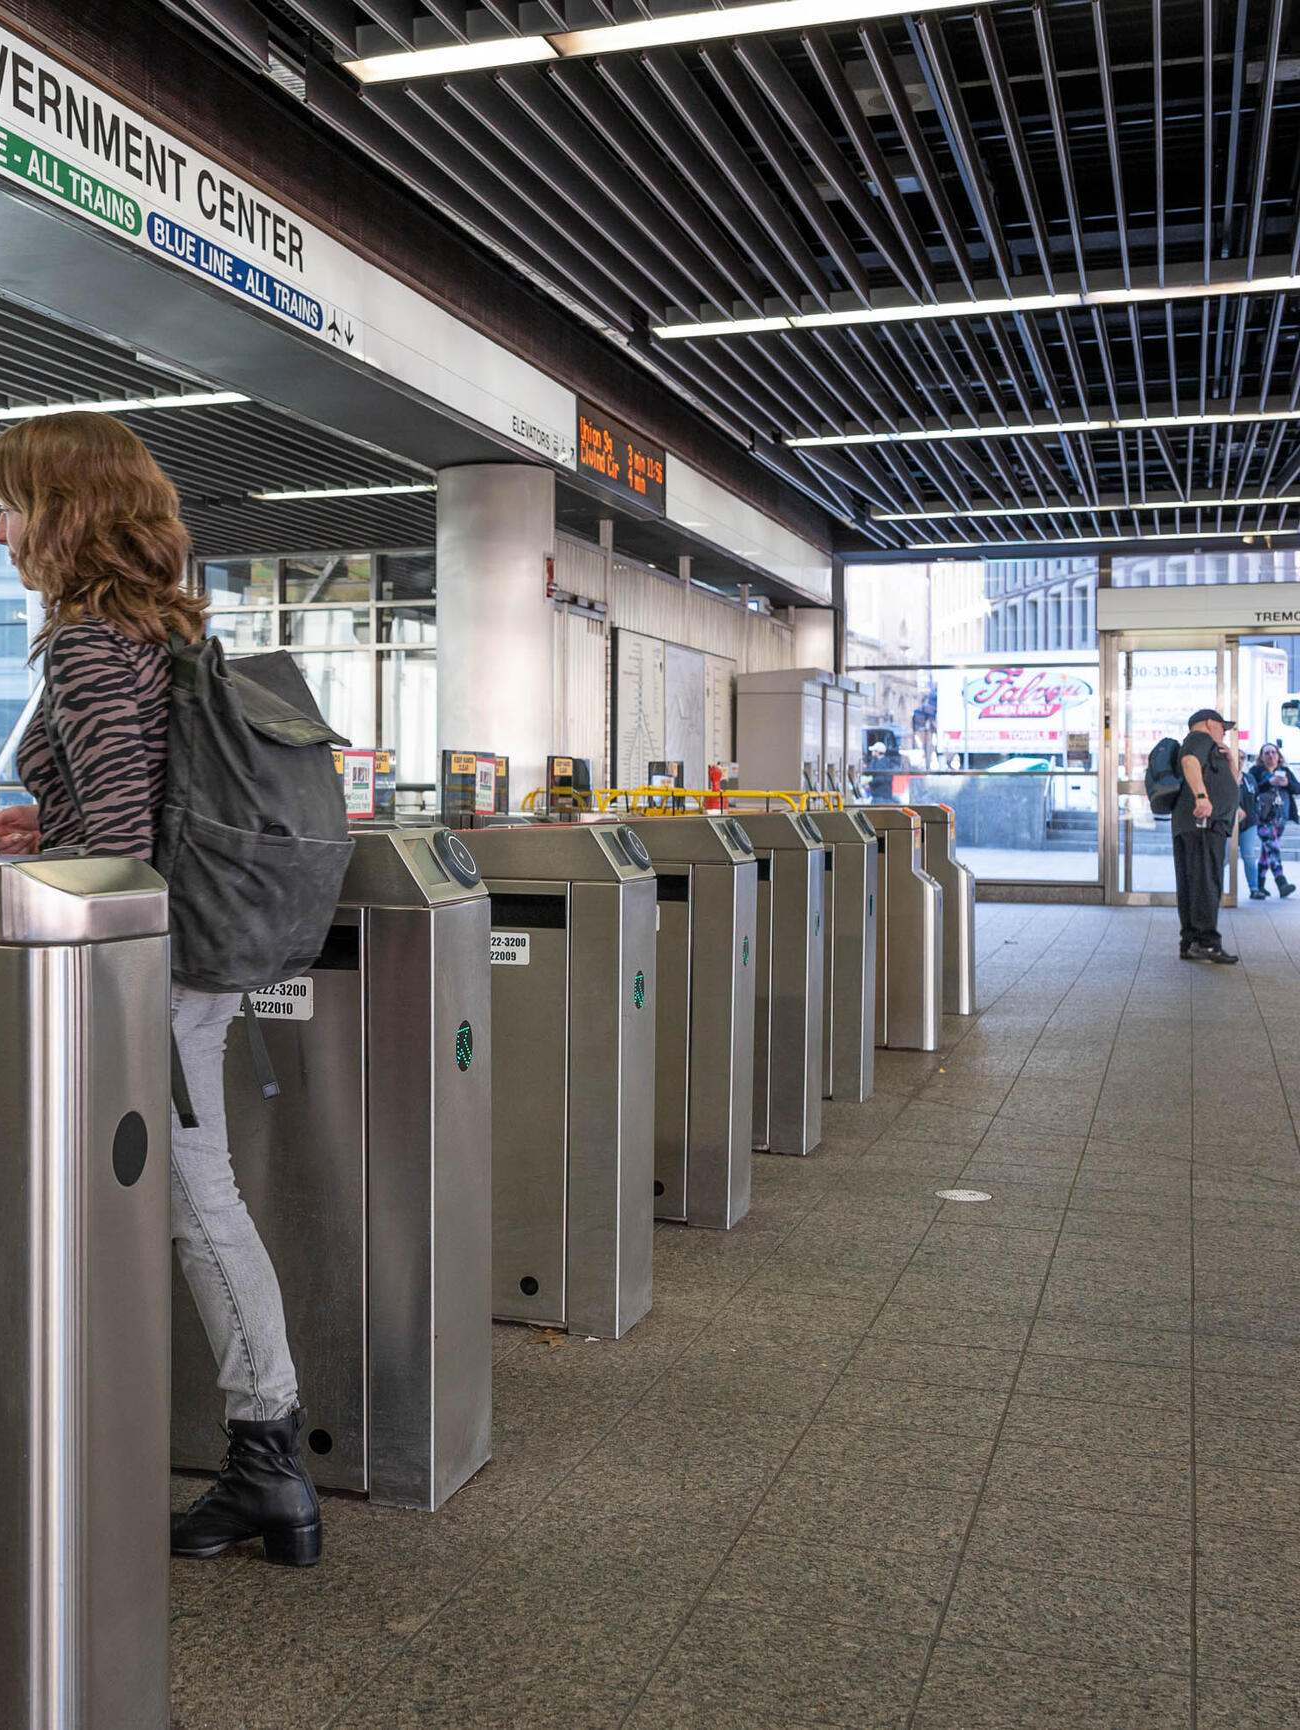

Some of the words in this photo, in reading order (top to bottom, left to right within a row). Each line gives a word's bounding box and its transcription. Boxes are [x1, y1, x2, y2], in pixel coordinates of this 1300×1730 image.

[26, 149, 65, 194] ALL
[68, 170, 136, 231] TRAINS
[196, 168, 304, 273] CENTER
[153, 217, 197, 261] BLUE
[200, 241, 234, 283] LINE
[245, 267, 271, 302] ALL
[273, 282, 320, 329] TRAINS
[512, 415, 551, 451] ELEVATORS
[579, 415, 602, 450] Union
[603, 429, 613, 456] Sq
[627, 443, 633, 468] 3
[633, 449, 646, 474] min
[627, 466, 633, 489] 4
[633, 471, 647, 496] min
[490, 951, 517, 961] 22009
[491, 936, 527, 947] 22-3200
[256, 983, 307, 997] 22-3200
[252, 1001, 294, 1015] 422010
